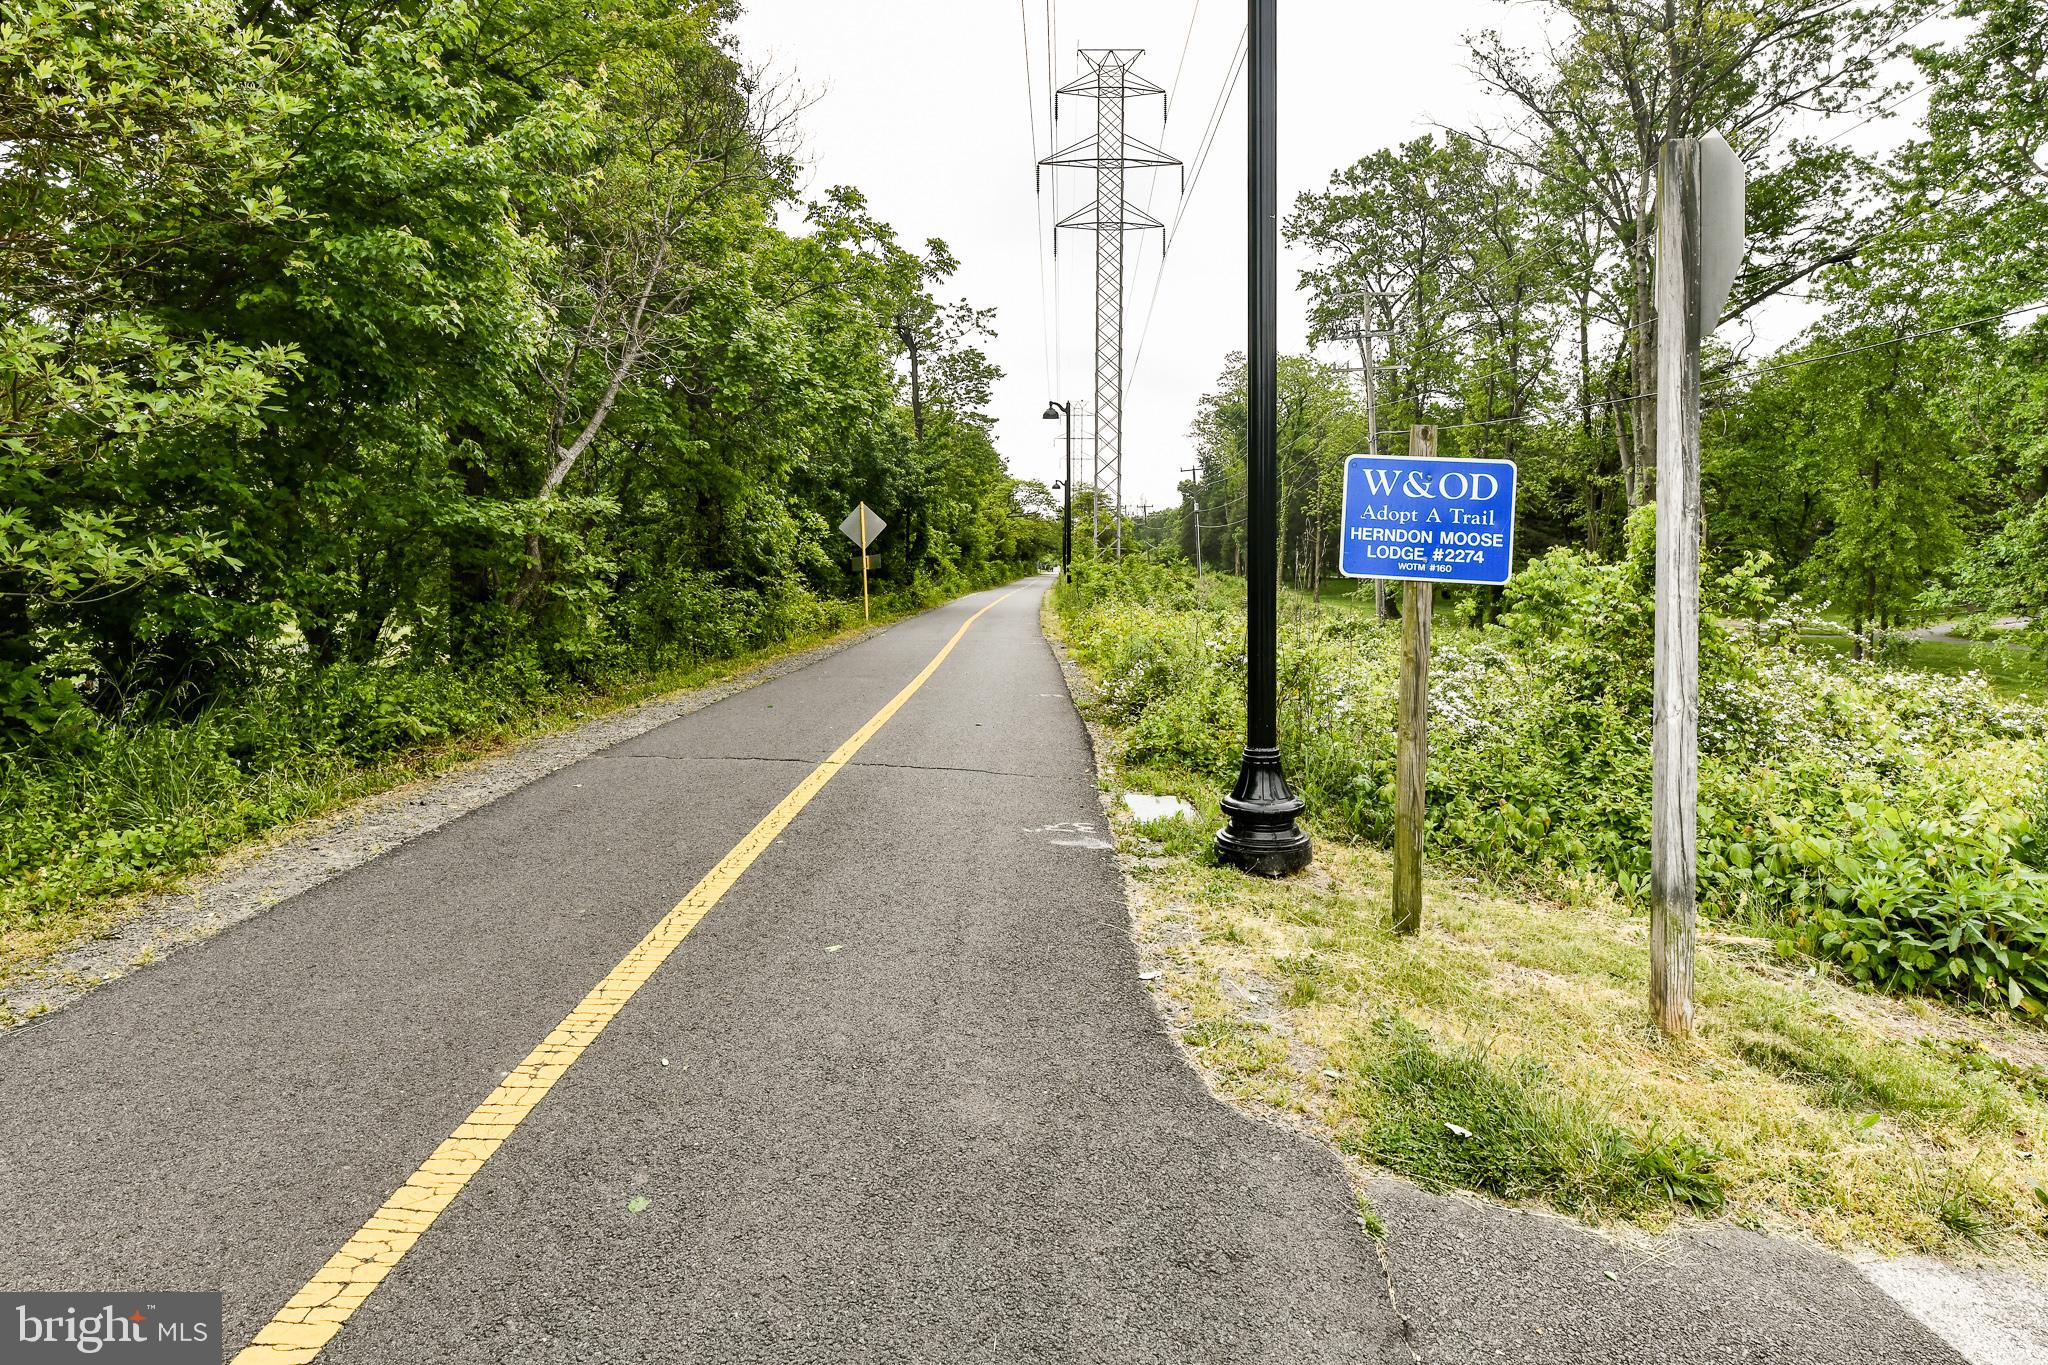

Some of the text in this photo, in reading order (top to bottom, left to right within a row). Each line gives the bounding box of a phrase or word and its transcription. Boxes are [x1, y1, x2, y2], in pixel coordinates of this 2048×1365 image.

[1363, 468, 1499, 501] W&OD
[1360, 504, 1495, 526] Adopt A Trail
[1350, 527, 1504, 547] HERNDON MOOSE
[1367, 545, 1485, 564] LODGE #2274
[1398, 562, 1452, 573] WOTM #160
